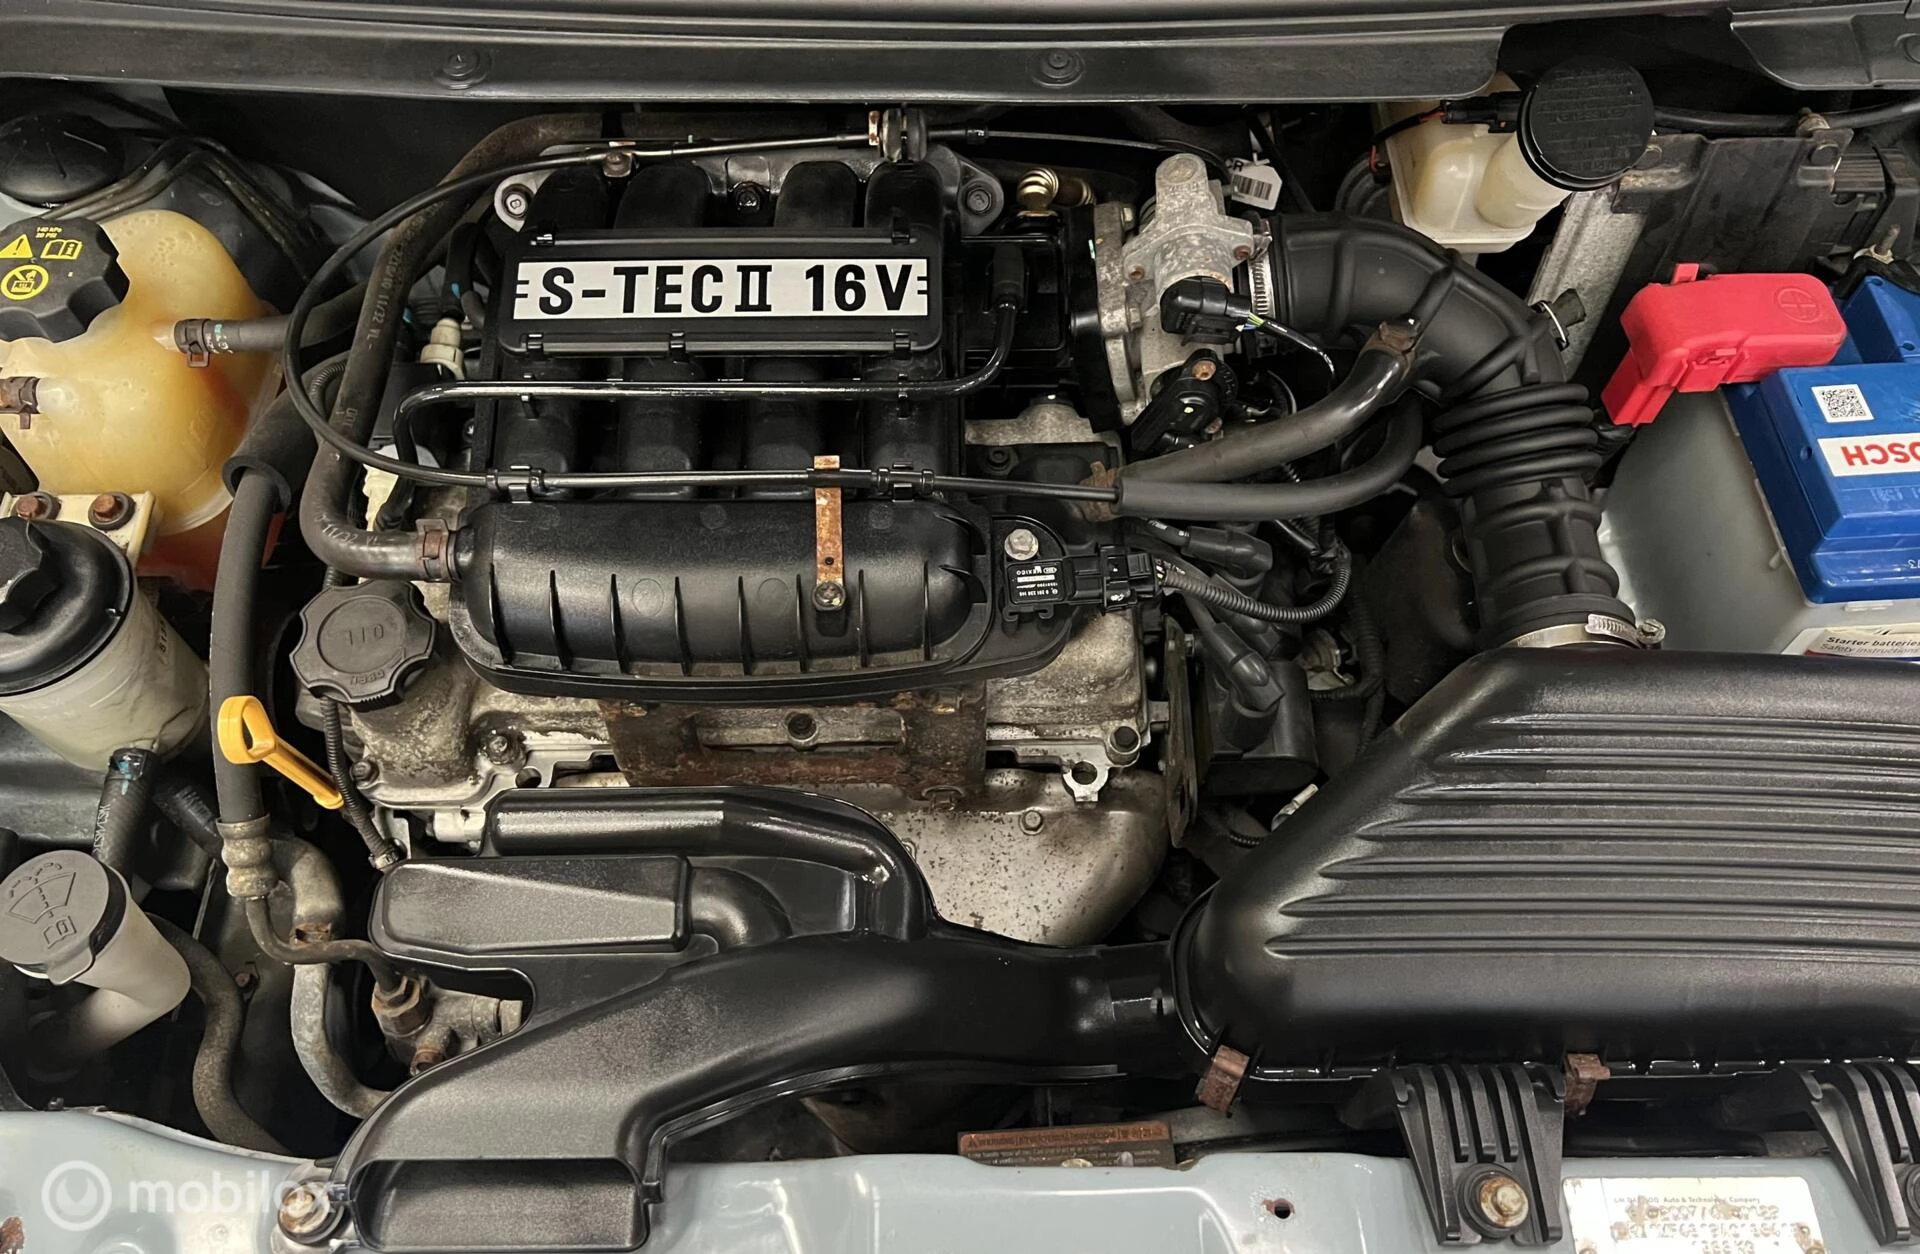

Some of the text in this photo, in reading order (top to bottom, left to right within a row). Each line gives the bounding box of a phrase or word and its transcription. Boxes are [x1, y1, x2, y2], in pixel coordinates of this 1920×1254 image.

[804, 264, 913, 312] 16V
[344, 623, 385, 647] OIL
[1827, 636, 1869, 646] Starter
[1821, 643, 1854, 653] Safety
[350, 669, 385, 685] OPEN
